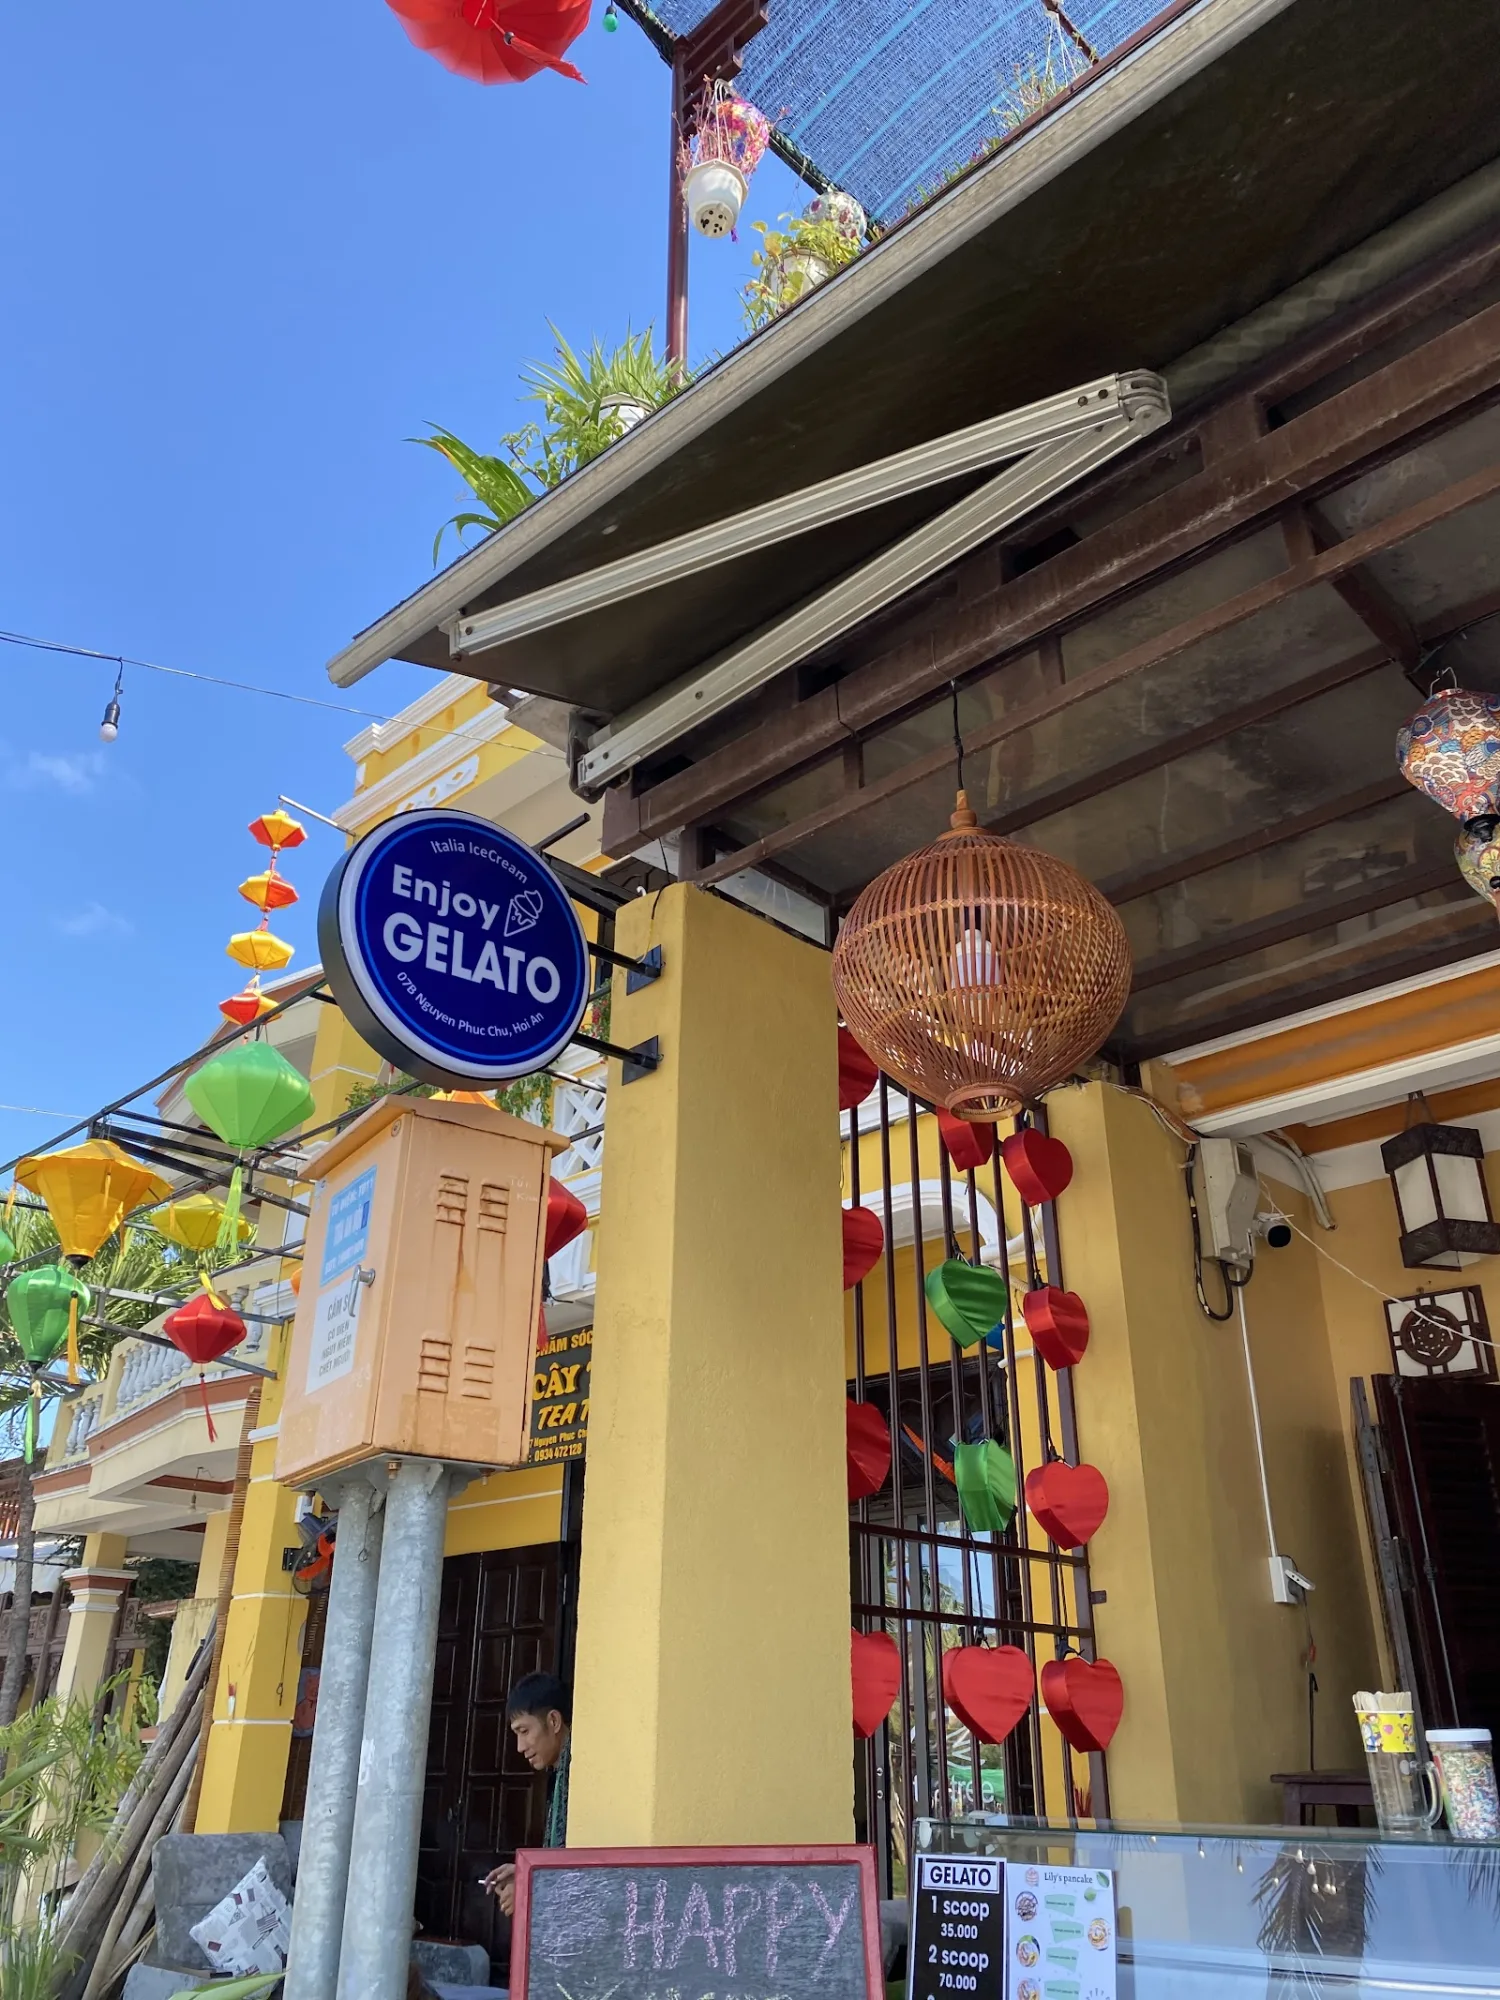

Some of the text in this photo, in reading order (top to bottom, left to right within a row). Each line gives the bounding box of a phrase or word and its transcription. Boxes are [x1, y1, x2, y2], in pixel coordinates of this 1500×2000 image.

[430, 838, 528, 885] Italia IceCream
[392, 863, 500, 931] Enjoy
[383, 912, 561, 1004] GELATO
[396, 971, 545, 1038] 07B Nguyen Phuc Chu, Hoi An
[533, 1362, 581, 1400] CÂY
[537, 1402, 577, 1430] TEA
[930, 1865, 991, 1887] GELATO
[1063, 1873, 1093, 1885] pancake
[931, 1895, 990, 1922] 1 scoop
[618, 1876, 859, 1982] HAPPY
[940, 1922, 978, 1940] 35.000
[928, 1944, 989, 1973] 2 scoop
[939, 1972, 977, 1991] 70.000
